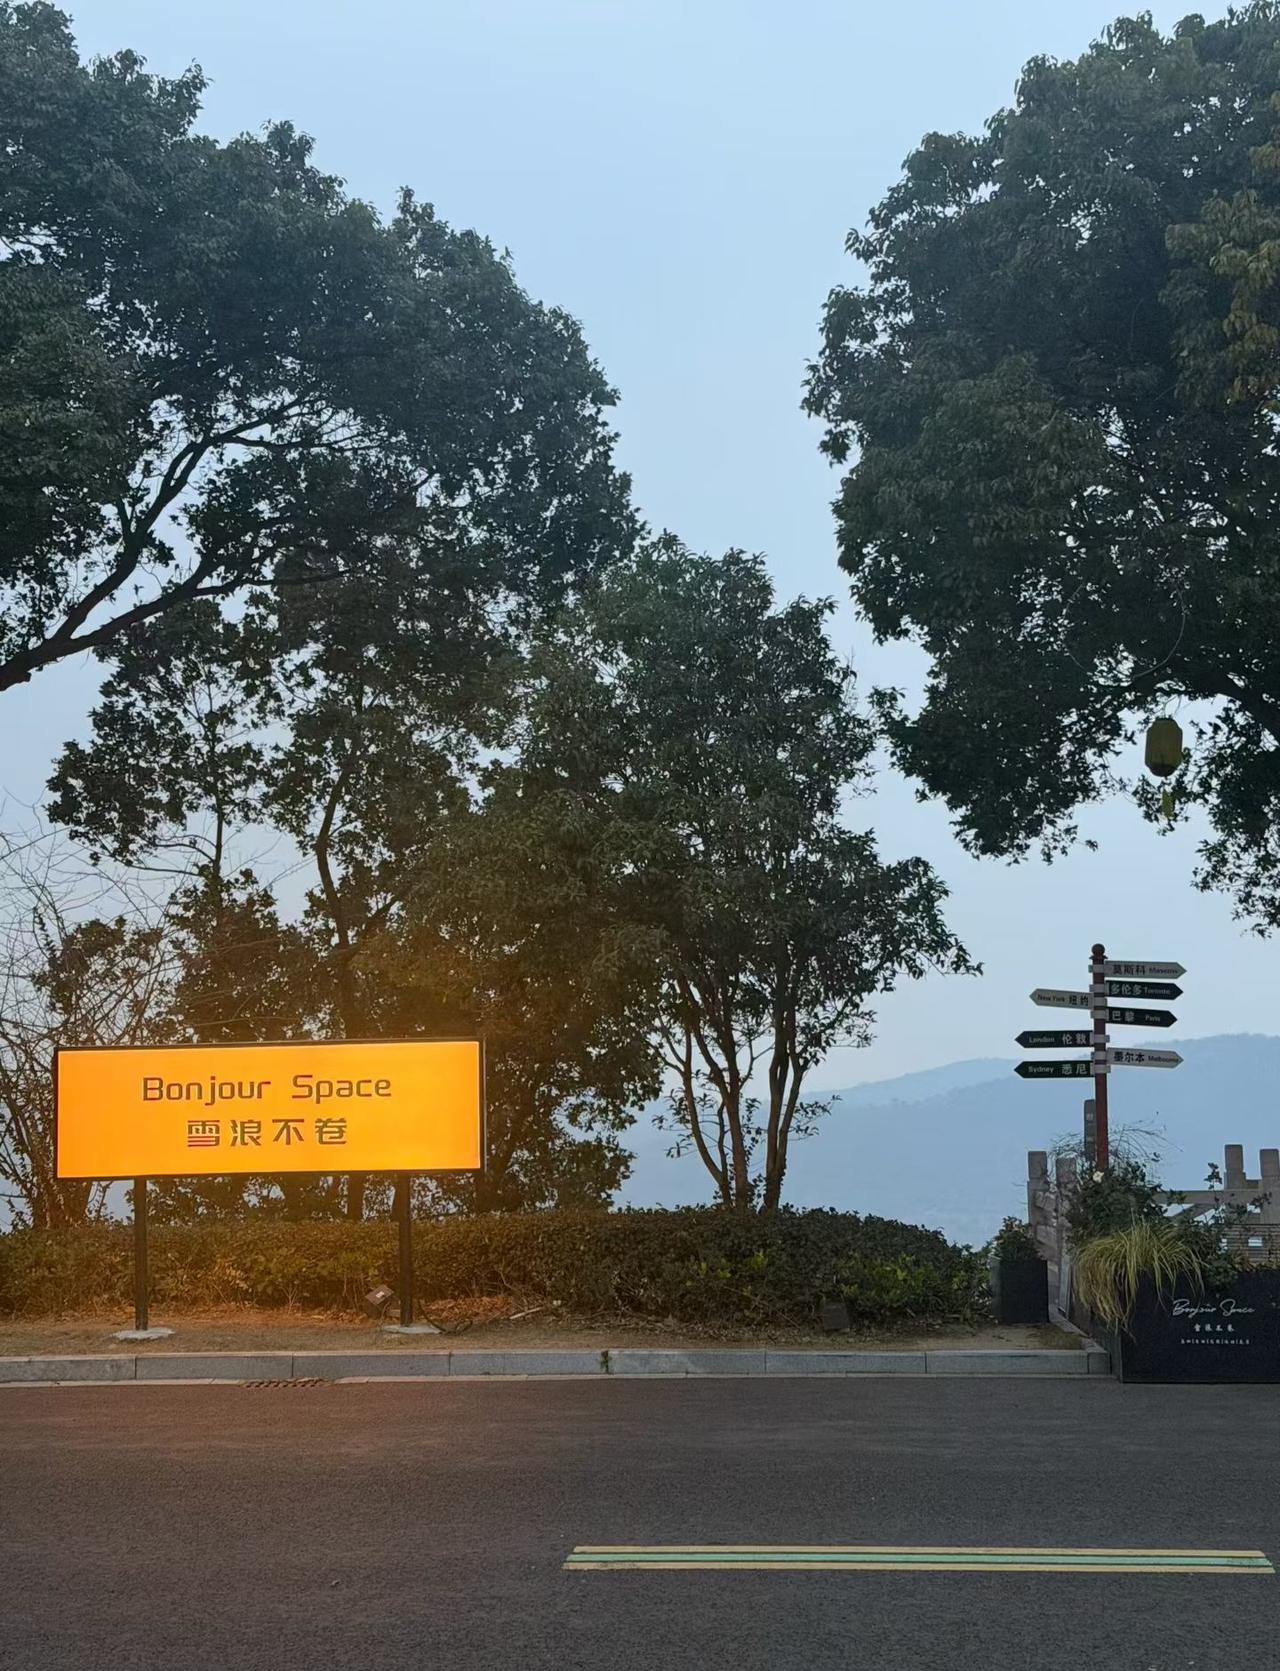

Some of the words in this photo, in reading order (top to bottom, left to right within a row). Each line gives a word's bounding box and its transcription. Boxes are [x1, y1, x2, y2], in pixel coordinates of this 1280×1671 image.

[1110, 983, 1142, 995] 多伦多
[1112, 1010, 1135, 1022] 巴黎
[1061, 1033, 1087, 1045] 伦敦
[1113, 1052, 1145, 1063] 墨尔本
[1028, 1066, 1054, 1074] Sydney
[1061, 1064, 1087, 1075] 悉尼
[142, 1075, 271, 1106] Bonjour
[291, 1074, 392, 1104] Space
[187, 1117, 348, 1148] 雪浪不卷
